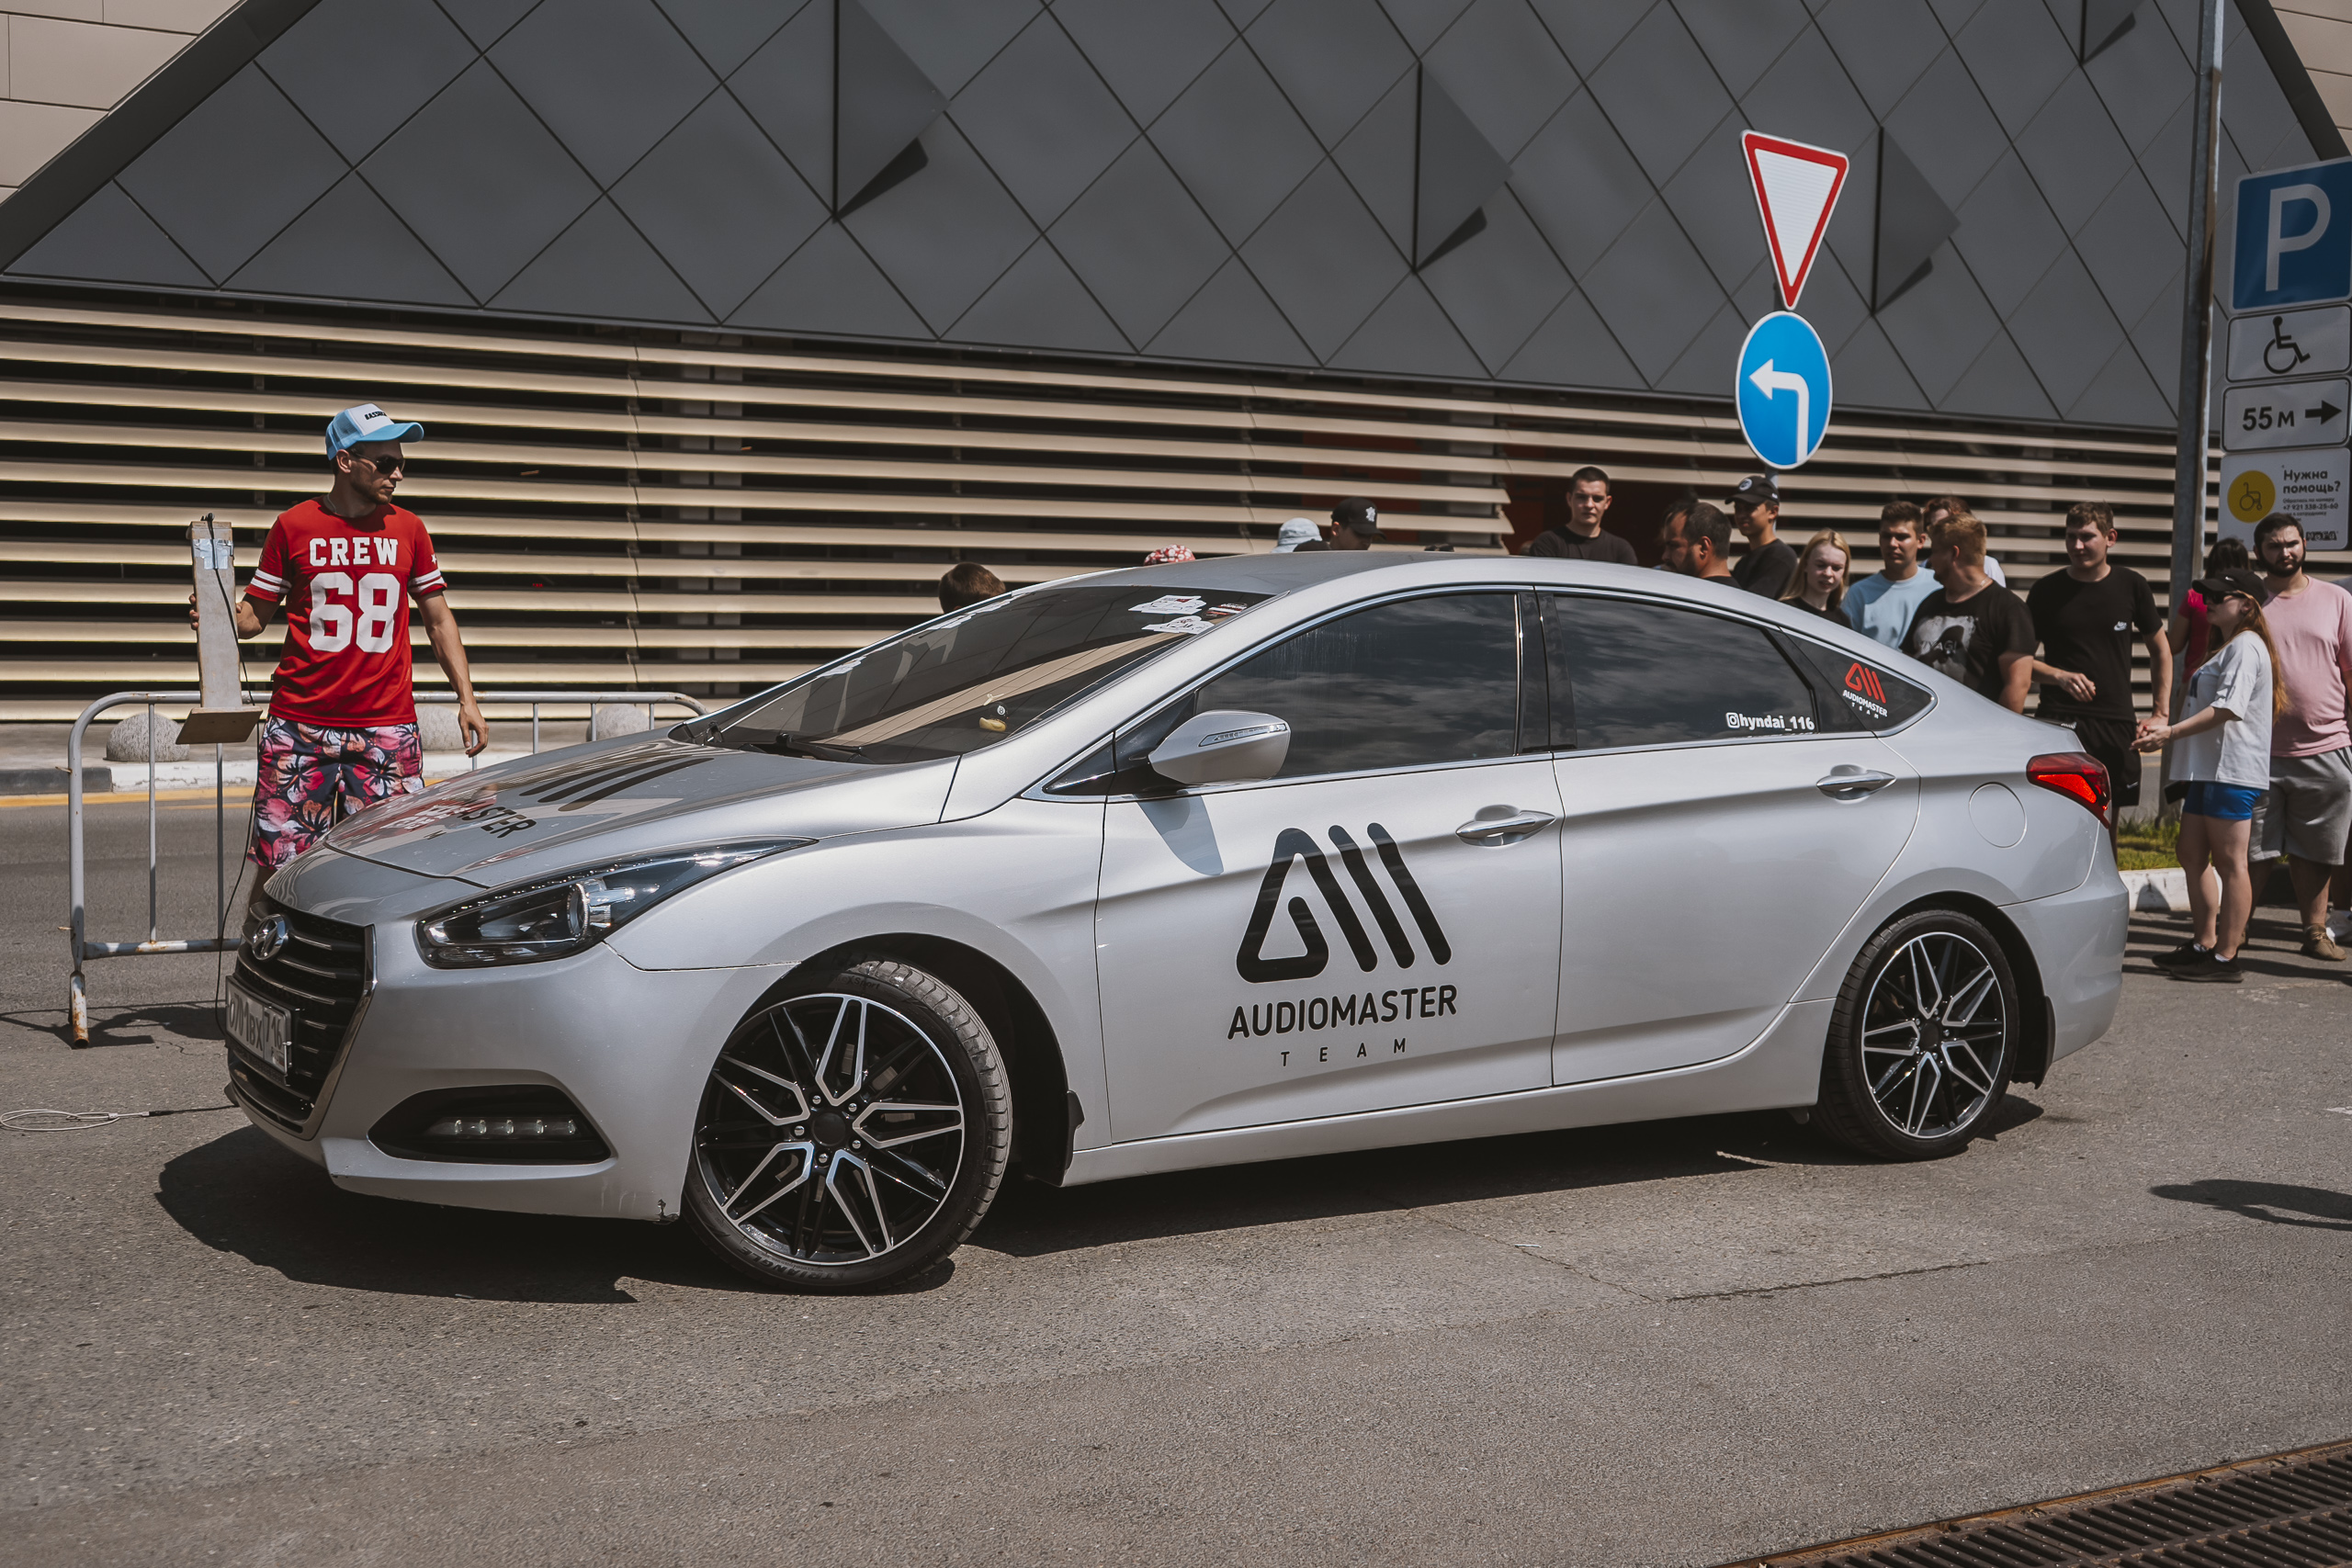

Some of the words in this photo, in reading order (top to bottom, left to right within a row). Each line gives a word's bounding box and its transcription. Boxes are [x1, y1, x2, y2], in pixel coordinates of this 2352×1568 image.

[2265, 183, 2332, 292] P
[2243, 406, 2273, 432] 55
[2282, 480, 2341, 494] помощь?
[2283, 469, 2328, 483] Нужна
[309, 536, 399, 567] CREW
[308, 571, 401, 653] 68
[1842, 689, 1889, 717] AUDIOMASTER
[1227, 984, 1458, 1041] AUDIOMASTER
[1280, 1037, 1407, 1067] TEAM
[738, 1246, 836, 1280] TRIANGLE
